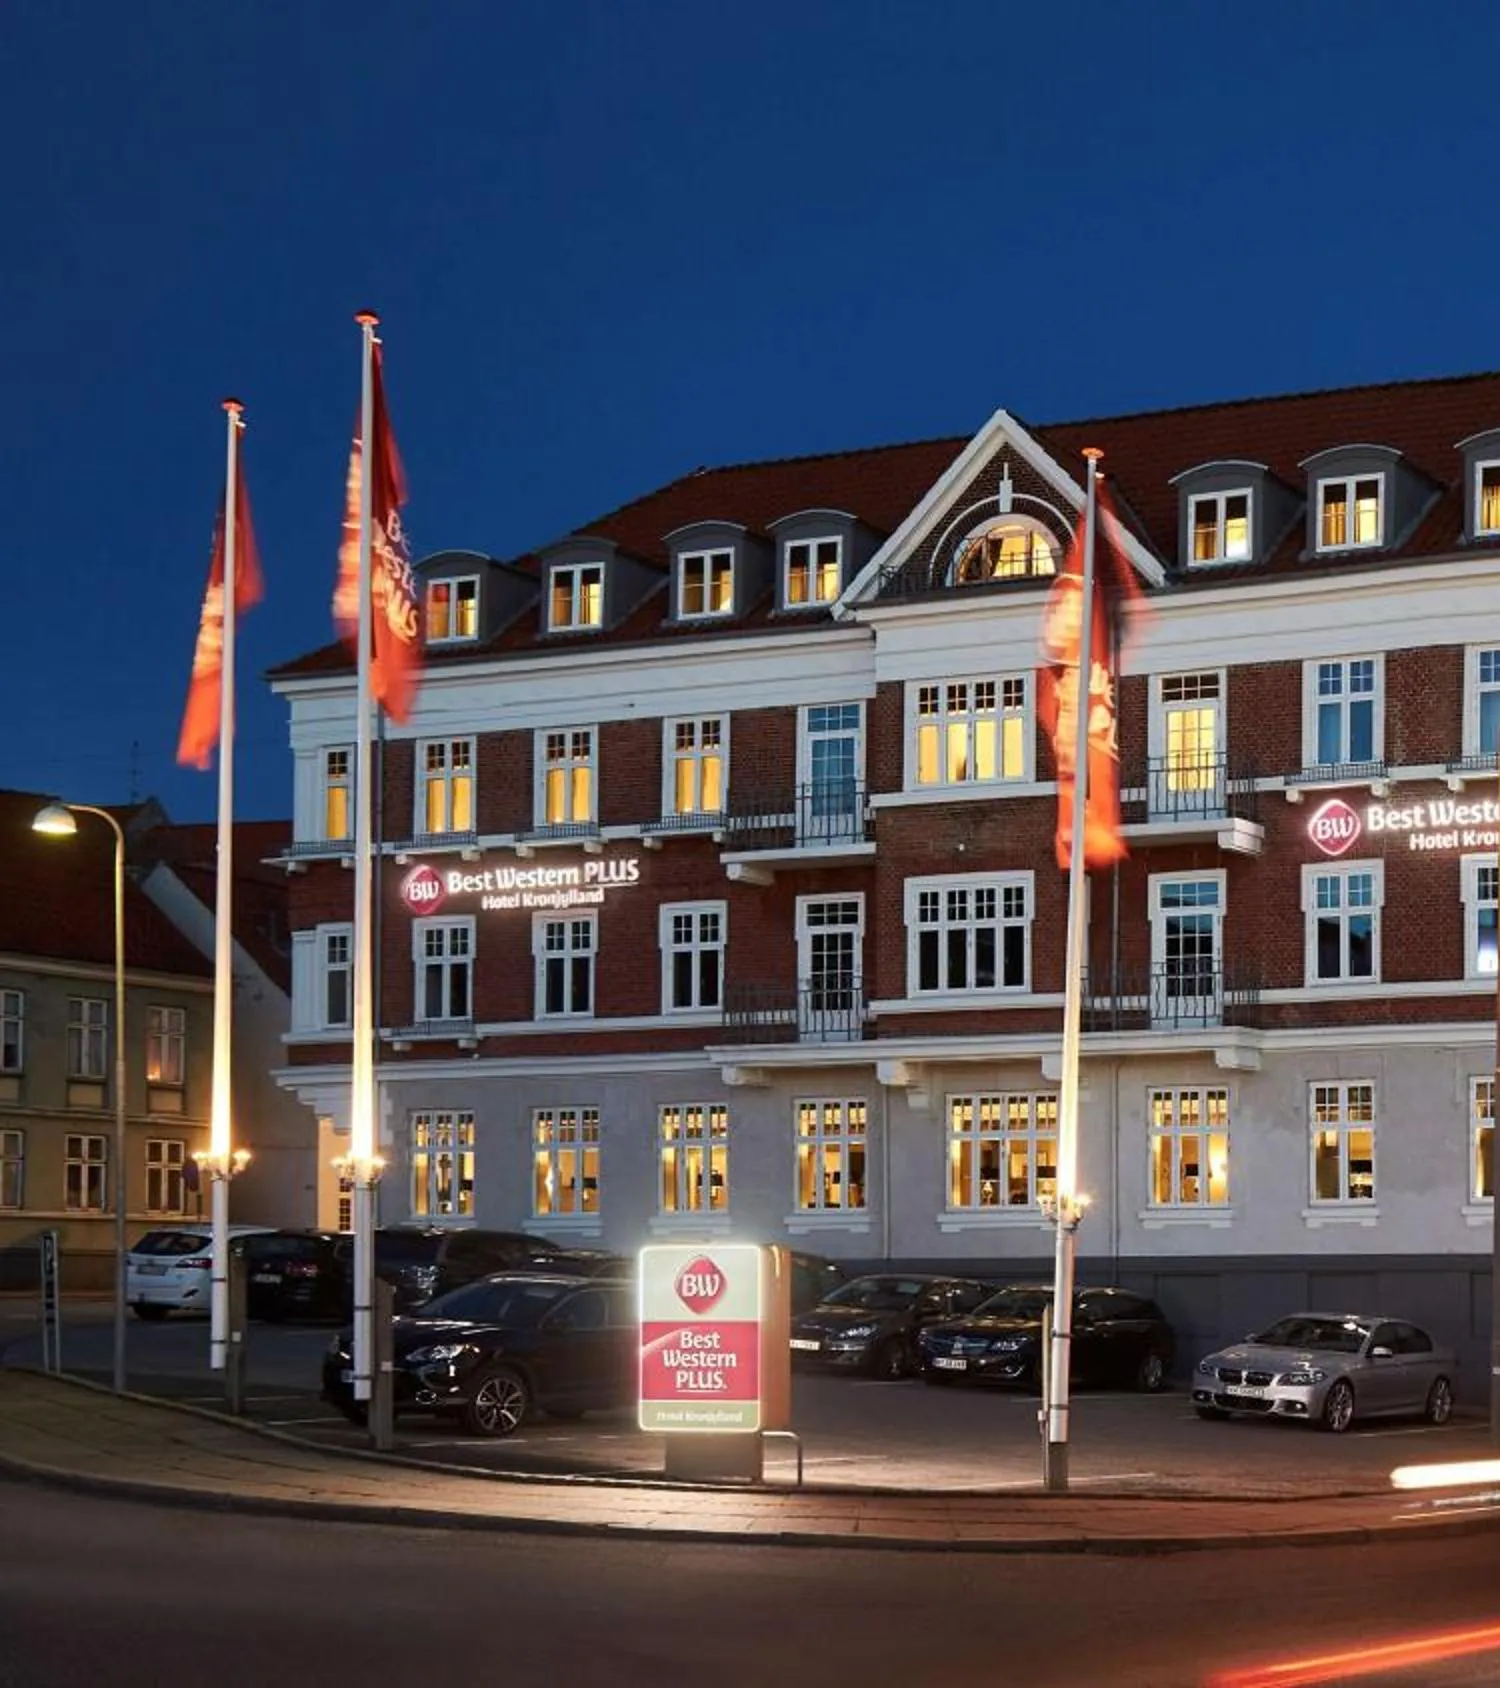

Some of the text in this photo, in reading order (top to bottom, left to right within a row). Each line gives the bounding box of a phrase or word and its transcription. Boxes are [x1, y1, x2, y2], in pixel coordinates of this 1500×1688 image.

[1316, 816, 1353, 840] BW
[1368, 804, 1425, 831] Best
[1410, 831, 1459, 850] Hotel
[449, 859, 640, 894] Best Western PLUS
[408, 879, 439, 902] BW
[482, 892, 520, 911] Hotel
[682, 1273, 720, 1297] BW
[681, 1331, 720, 1349] Best
[663, 1350, 737, 1368] Western
